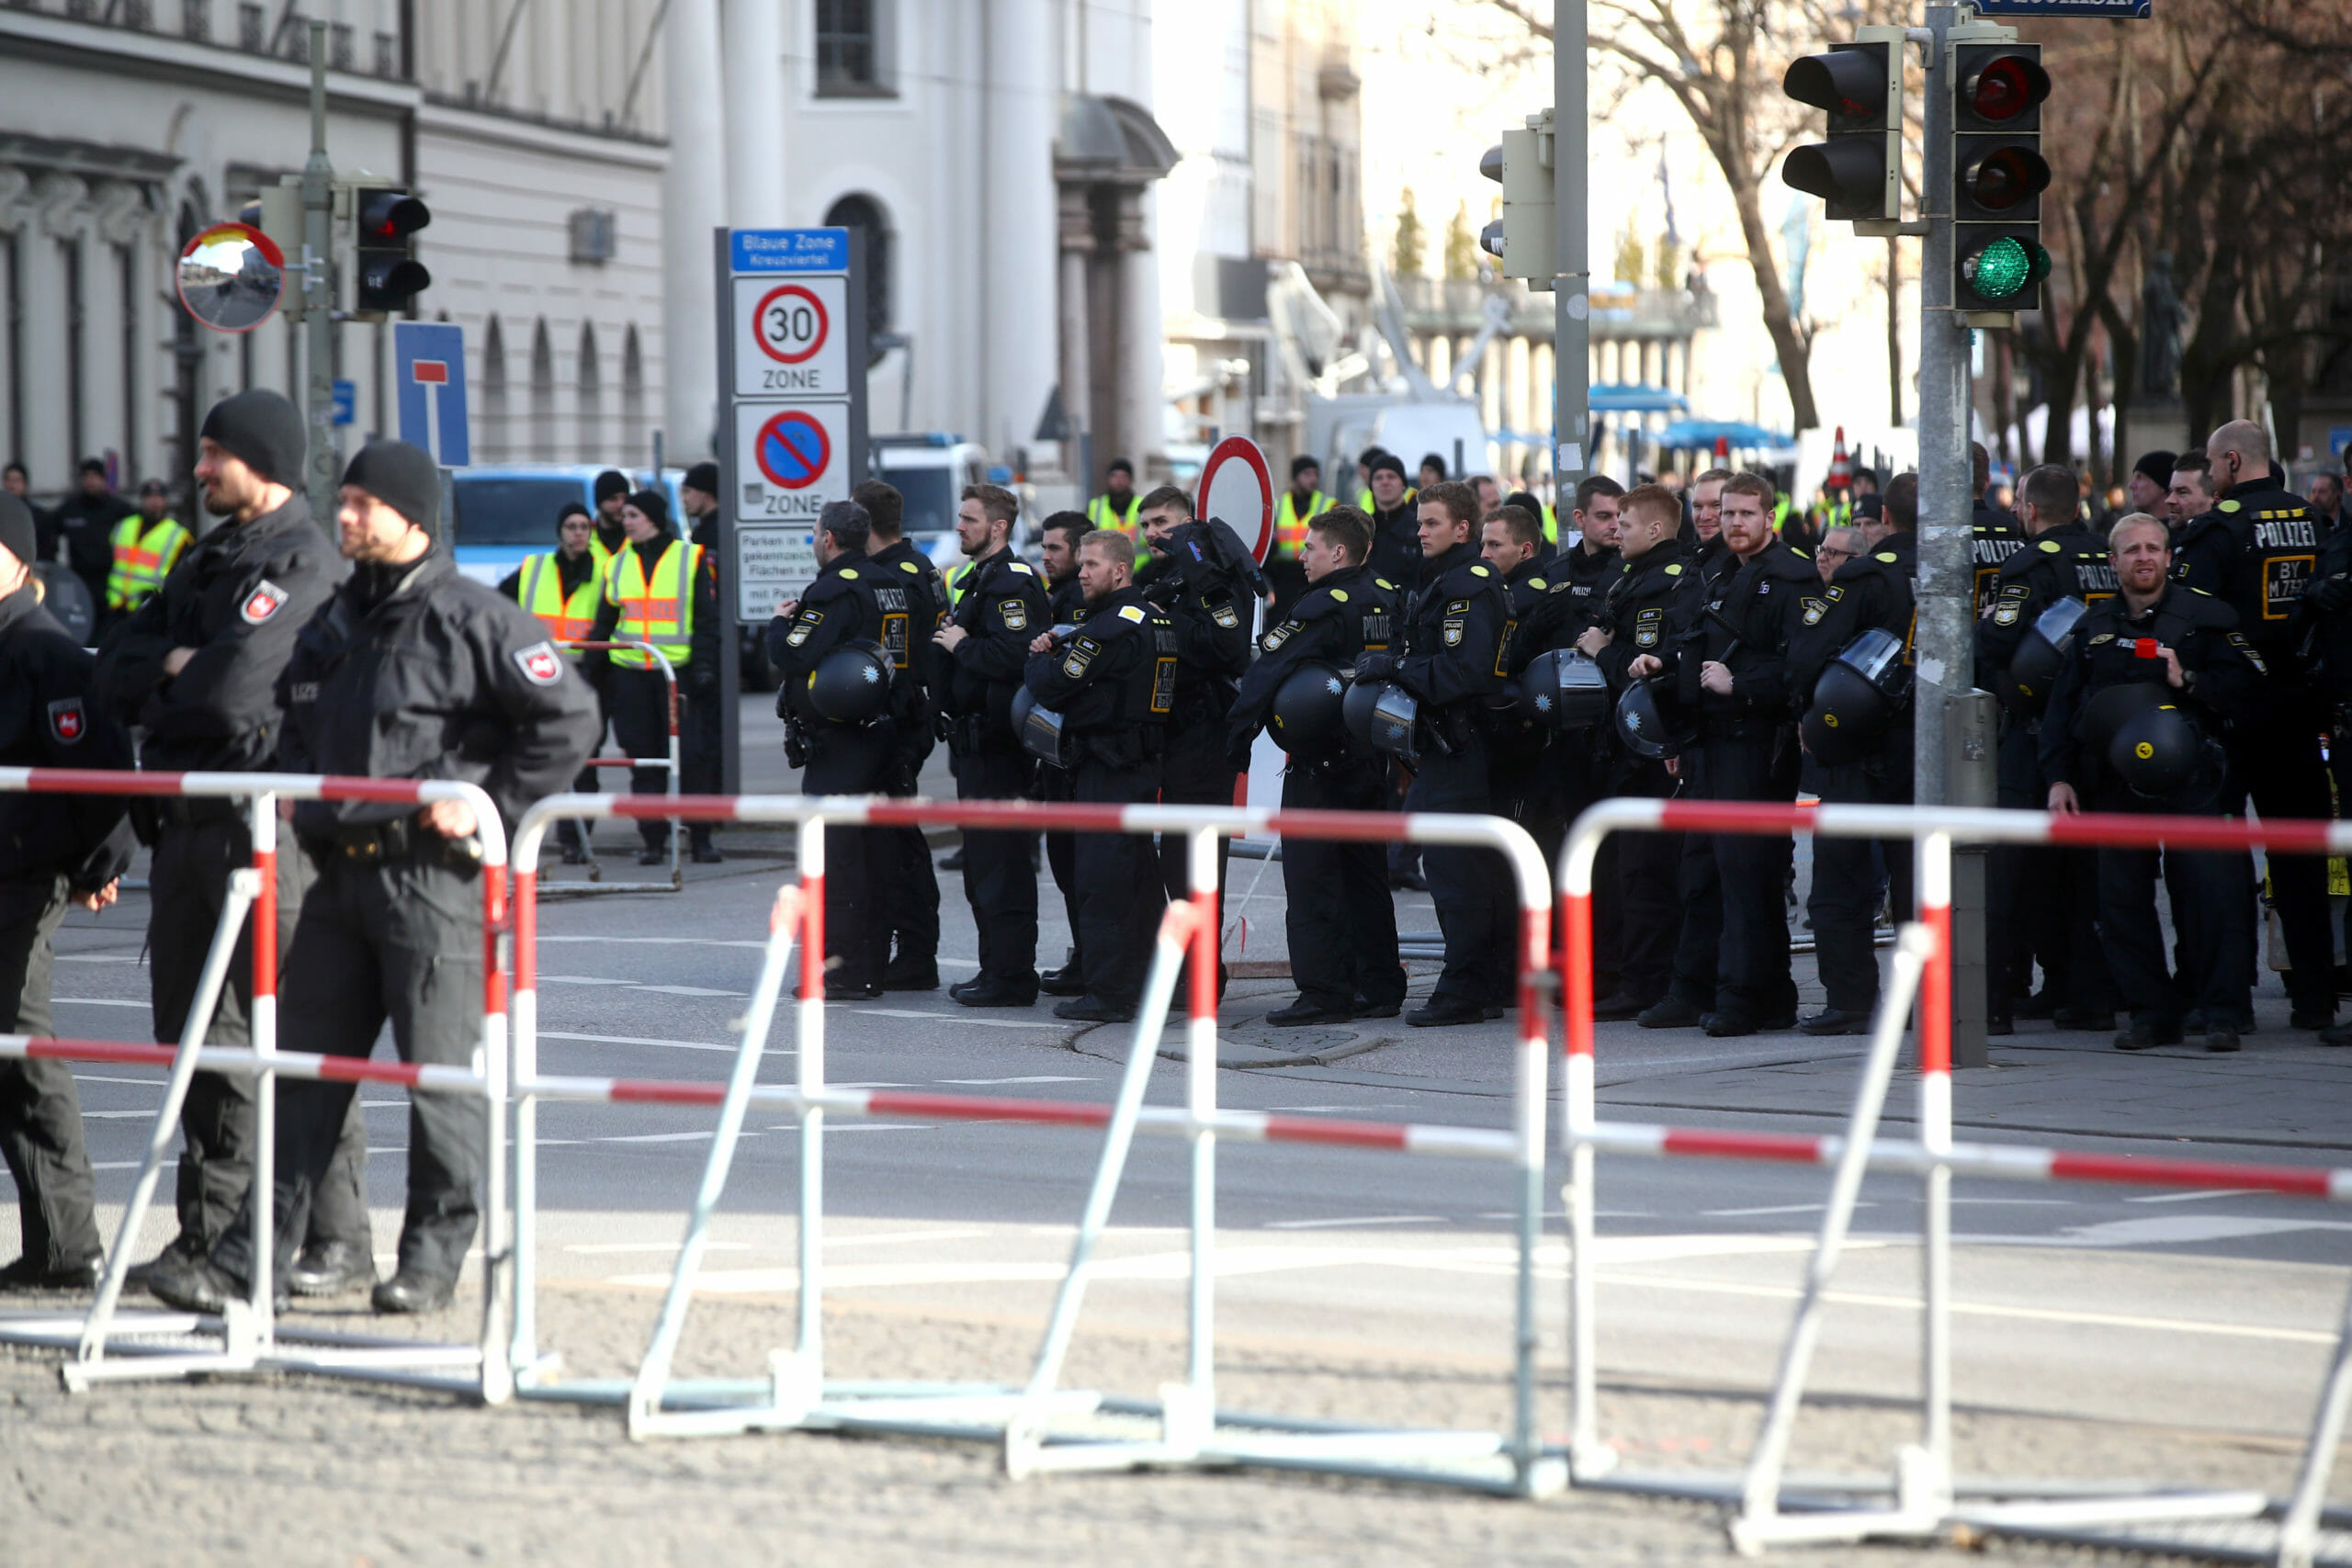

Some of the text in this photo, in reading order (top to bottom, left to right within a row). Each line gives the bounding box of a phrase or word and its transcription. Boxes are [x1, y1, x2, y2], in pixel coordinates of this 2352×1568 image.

[742, 234, 836, 251] Blaue Zone
[770, 306, 811, 342] 30
[763, 369, 820, 389] ZONE
[765, 495, 822, 513] ZONE
[741, 536, 781, 546] Parken
[2254, 521, 2316, 548] POLIZEI
[2279, 561, 2301, 580] BY
